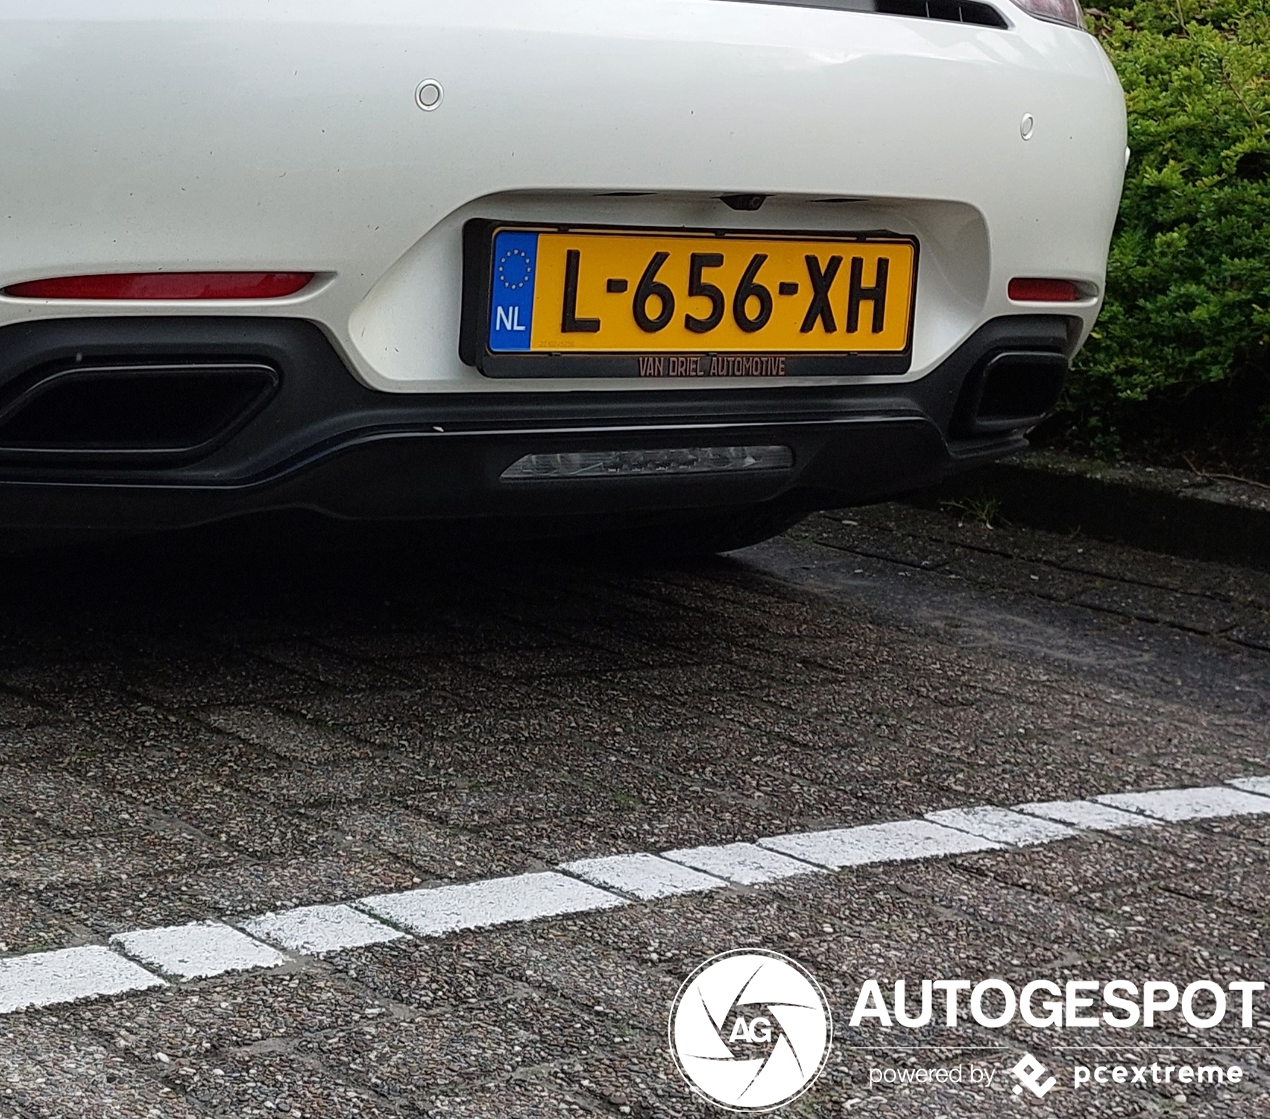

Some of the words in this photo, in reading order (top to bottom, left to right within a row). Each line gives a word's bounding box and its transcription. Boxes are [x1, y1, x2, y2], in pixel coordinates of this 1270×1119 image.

[561, 249, 890, 334] L-656-XH
[495, 305, 526, 331] NL
[639, 357, 664, 377] VAN
[668, 357, 704, 377] DRIEL
[709, 356, 786, 377] AUTOMOTIVE
